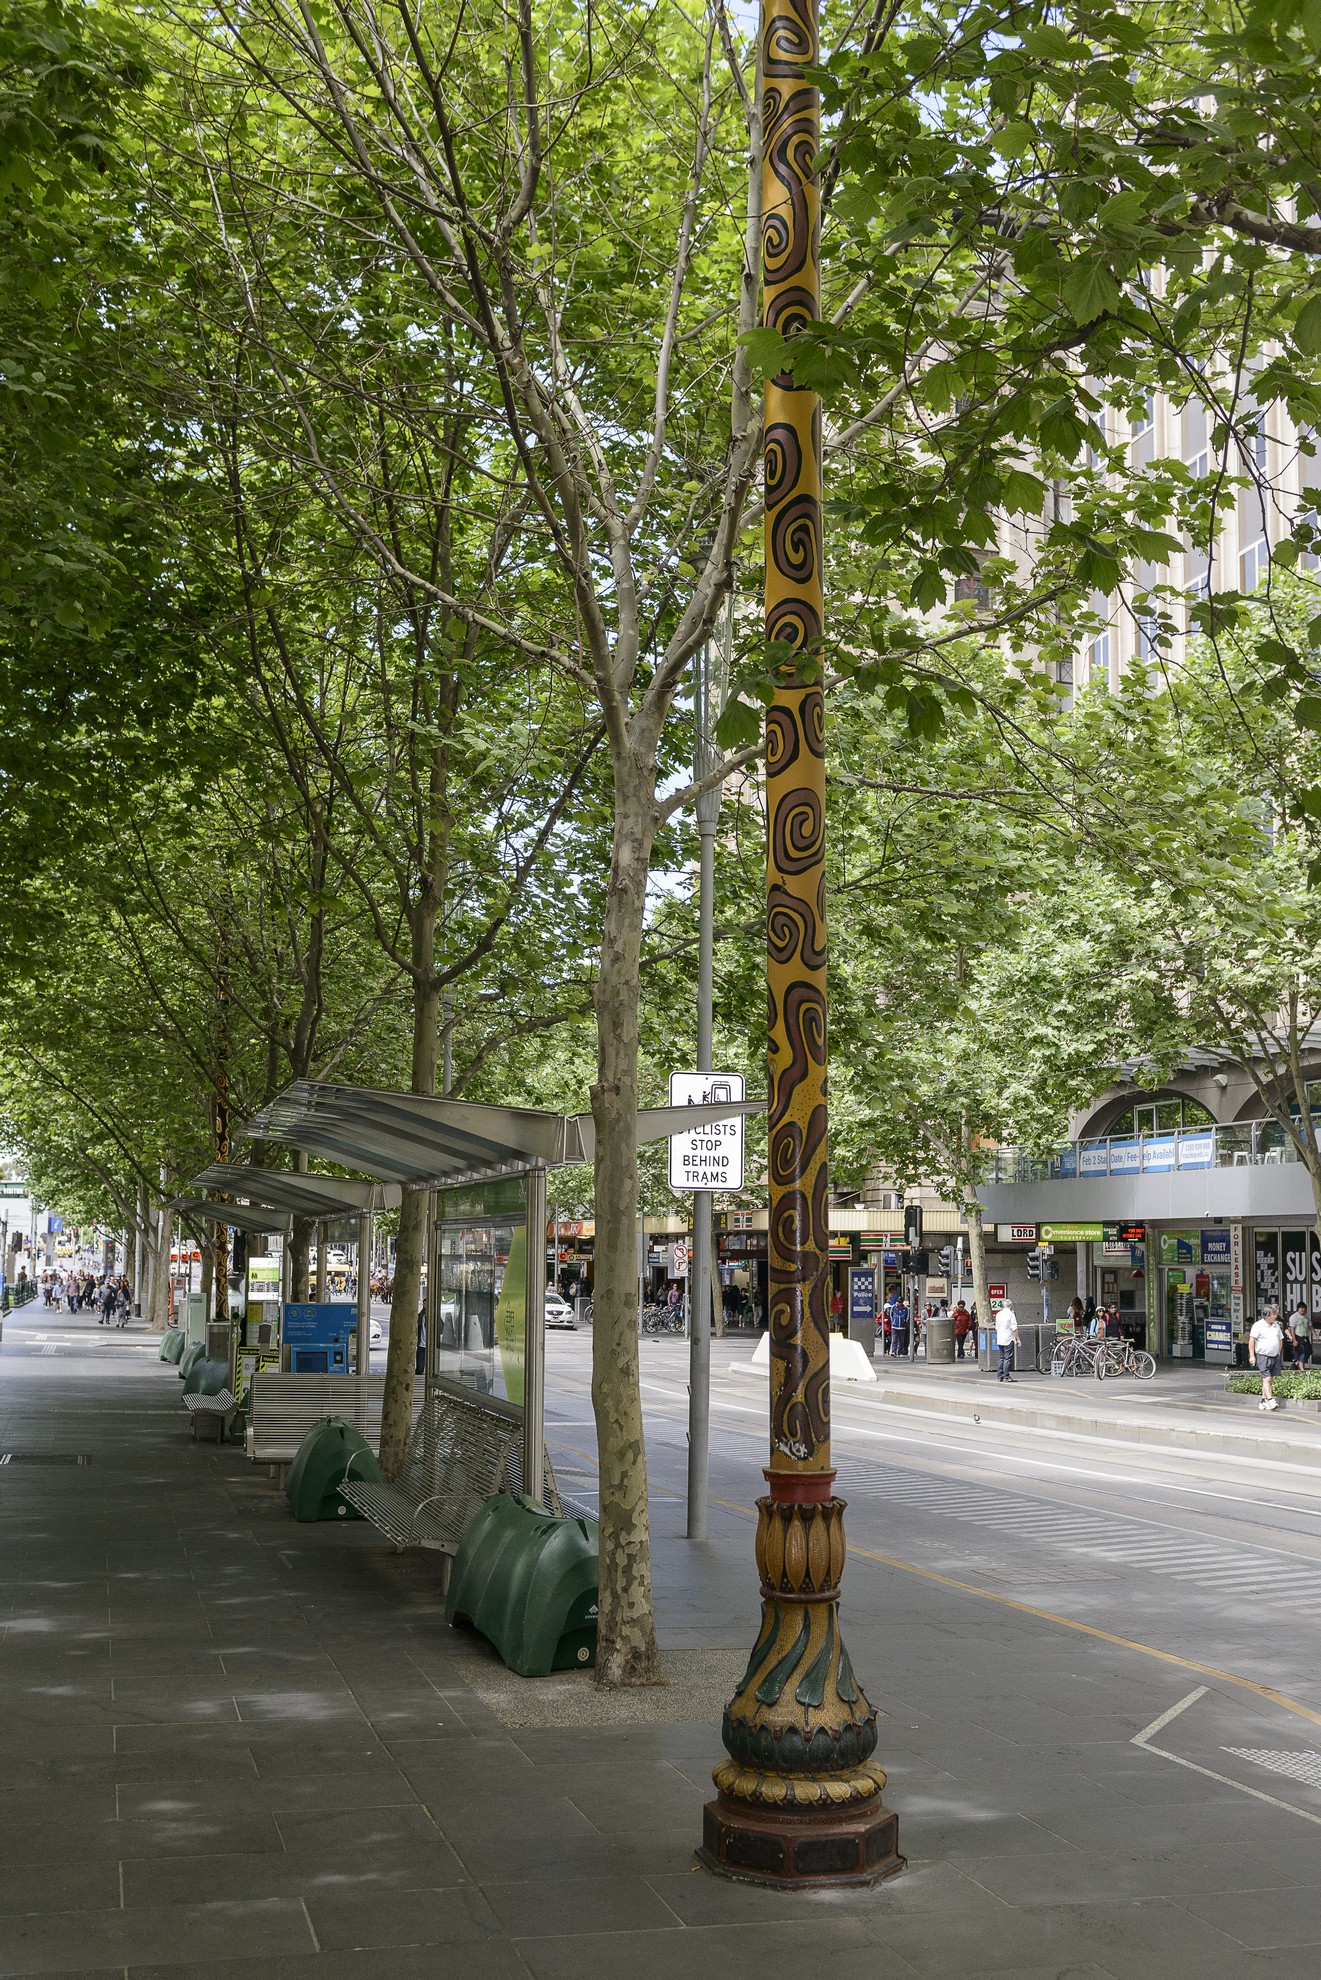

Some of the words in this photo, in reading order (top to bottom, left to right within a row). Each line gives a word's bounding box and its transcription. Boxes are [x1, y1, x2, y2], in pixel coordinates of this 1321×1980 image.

[678, 1124, 736, 1136] CLISTS
[691, 1139, 722, 1151] STOP
[683, 1155, 729, 1167] BEHIND
[1082, 1155, 1092, 1166] Feb
[1092, 1155, 1097, 1165] 2
[1152, 1147, 1175, 1160] Availabl
[685, 1170, 728, 1183] TRAMS
[1012, 1229, 1034, 1237] LORD
[1041, 1226, 1084, 1240] Convenience
[1208, 1242, 1226, 1252] MONEY
[1204, 1253, 1231, 1263] EXCHANGE
[992, 1300, 1003, 1308] 24
